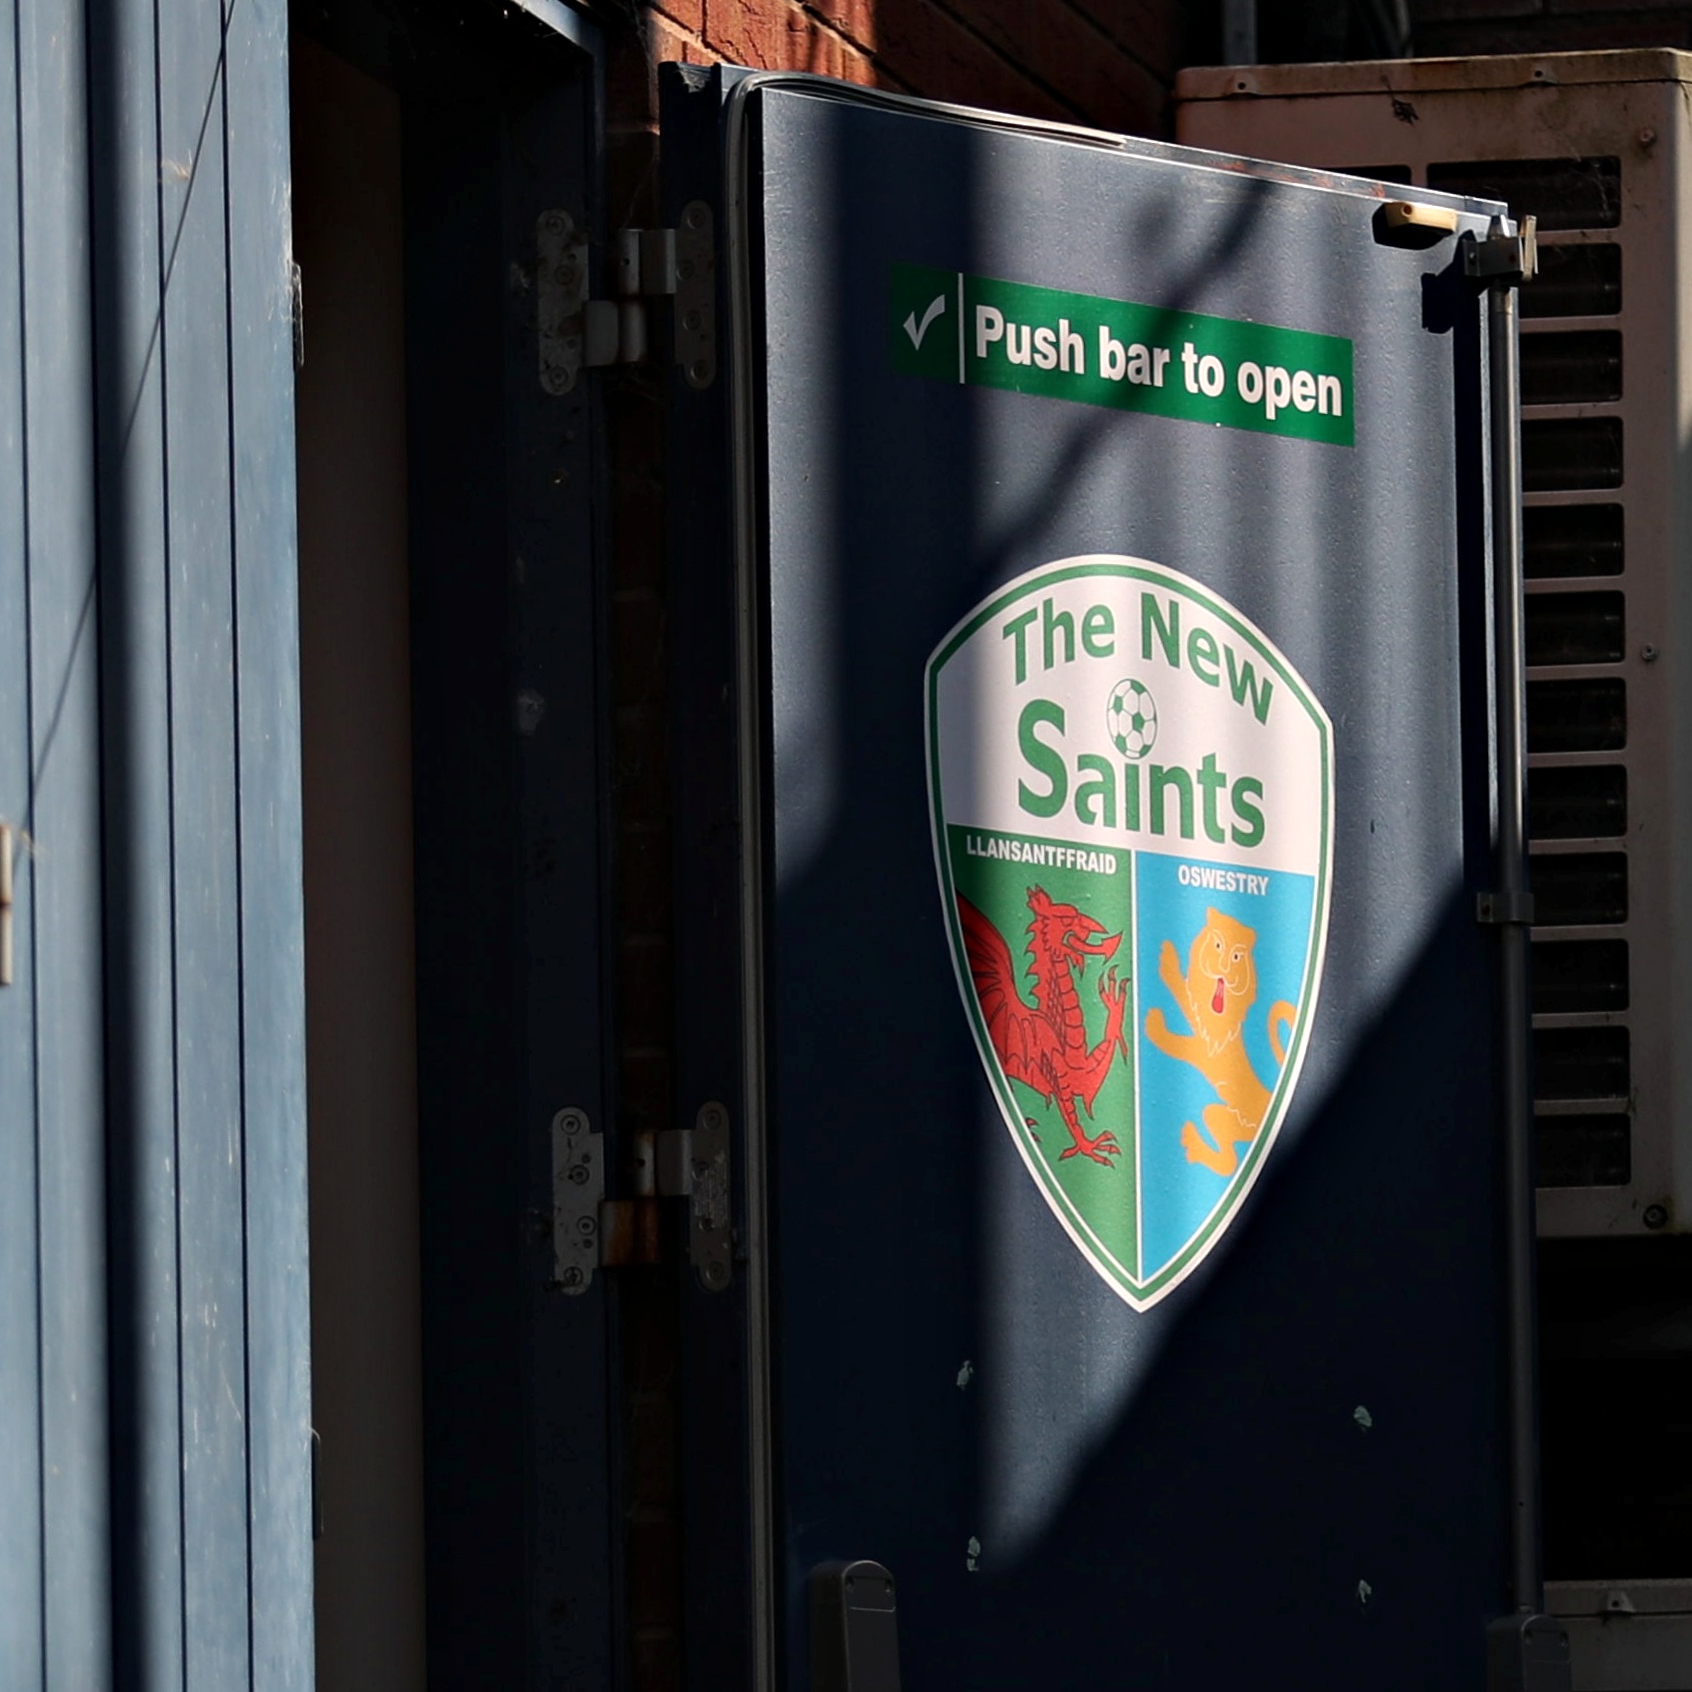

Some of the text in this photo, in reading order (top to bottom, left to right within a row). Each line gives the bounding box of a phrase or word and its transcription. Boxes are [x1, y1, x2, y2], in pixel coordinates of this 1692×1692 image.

[976, 306, 1342, 420] Push bar to open
[1004, 593, 1273, 724] The New
[1018, 700, 1265, 847] Saints
[967, 835, 1116, 874] LLANSANTFFRAID
[1179, 865, 1269, 895] OSWESTRY
